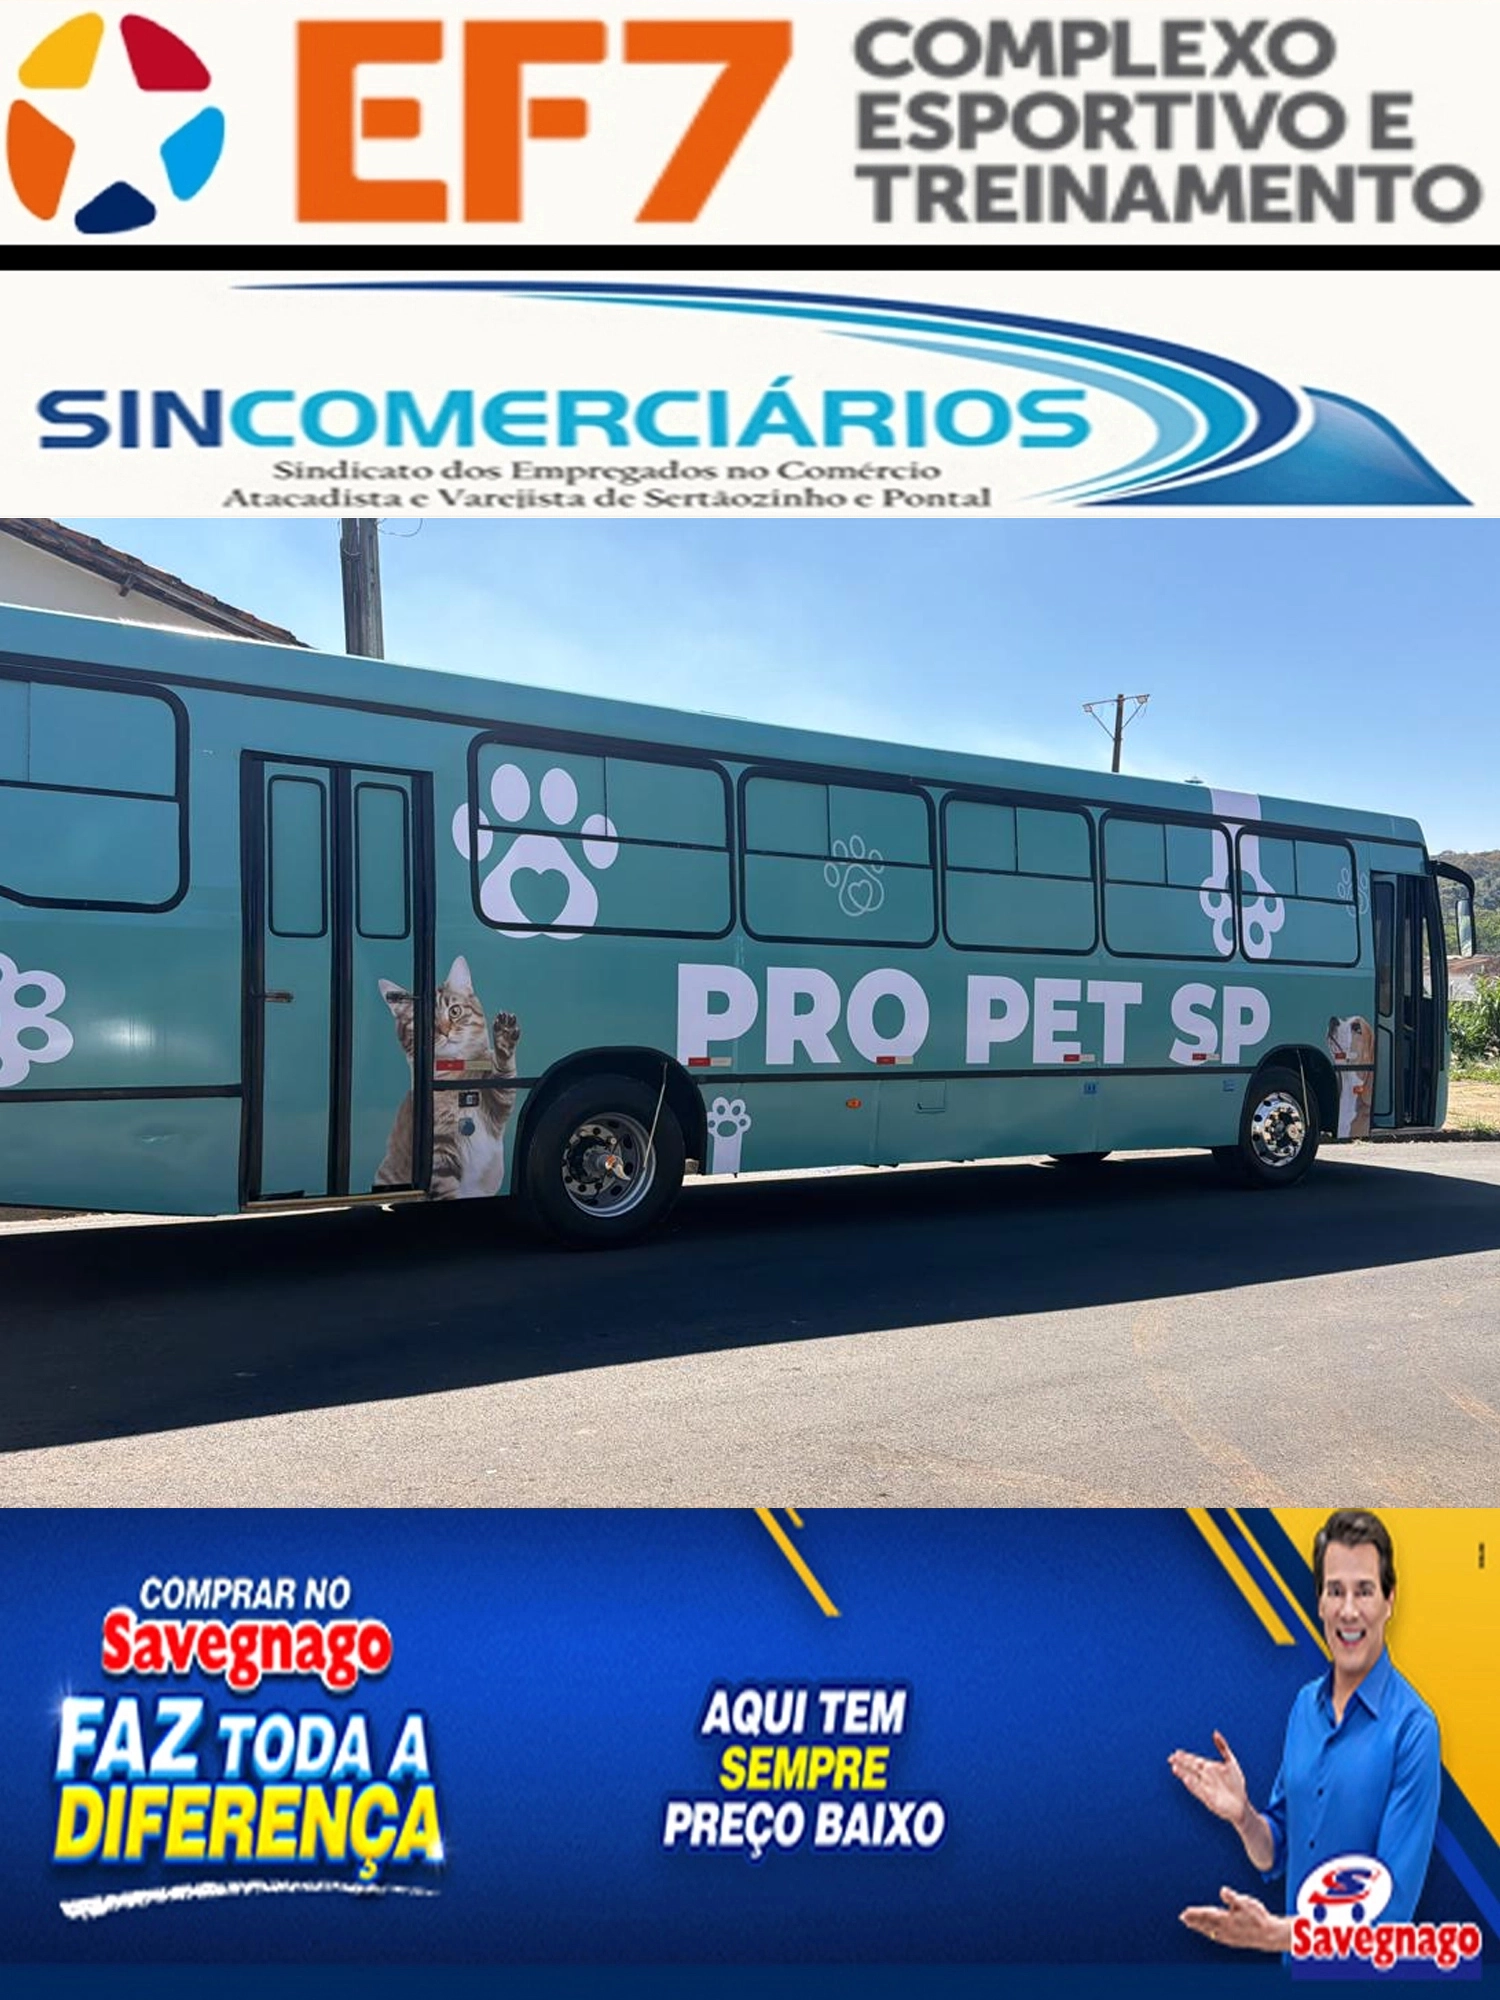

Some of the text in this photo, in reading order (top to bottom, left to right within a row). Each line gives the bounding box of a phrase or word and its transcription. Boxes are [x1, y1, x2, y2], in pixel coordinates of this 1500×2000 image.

[854, 18, 1337, 79] COMPLEXO
[295, 19, 793, 223] EF7
[855, 90, 1414, 152] ESPORTIVO E
[854, 163, 1483, 224] TREINAMENTO
[36, 375, 1092, 449] SINCOMERCIÁRIOS
[222, 487, 992, 510] Atacadista e Varejista de Sertãozinho e Pontal
[272, 460, 942, 486] Sindicato dos Empregados no Comércio
[677, 963, 1271, 1065] PRO PET SP
[140, 1576, 351, 1611] COMPRAR NO
[102, 1608, 393, 1690] Savegnago
[55, 1696, 431, 1780] FAZ TODA A
[701, 1689, 907, 1737] AQUI TEM
[719, 1746, 890, 1791] SEMPRE
[52, 1783, 445, 1881] DIFERENÇA
[662, 1801, 946, 1859] PREÇO BAIXO
[1292, 1917, 1481, 1968] Savegnago
